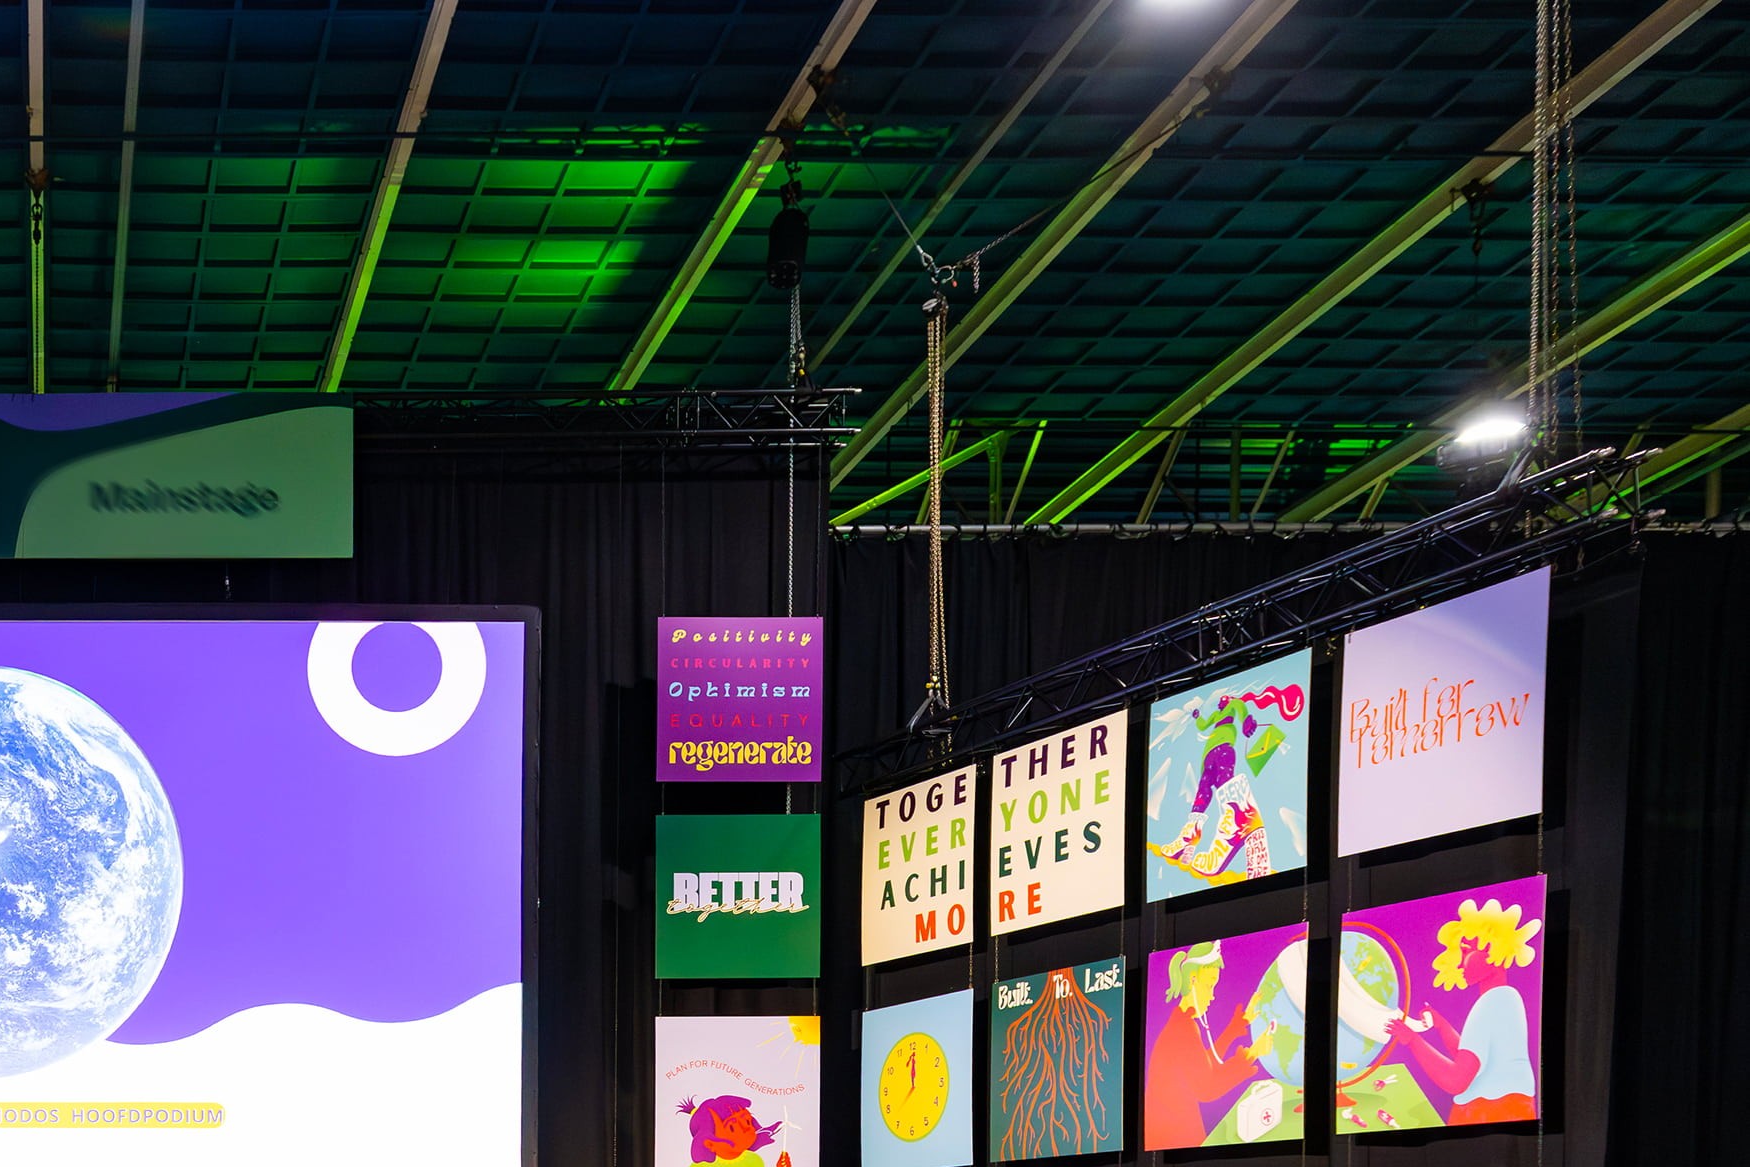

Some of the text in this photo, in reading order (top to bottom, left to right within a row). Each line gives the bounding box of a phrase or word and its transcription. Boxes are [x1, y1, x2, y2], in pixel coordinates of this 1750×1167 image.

[671, 629, 812, 647] Positivity
[670, 658, 809, 668] CIRCULARITY
[669, 681, 811, 701] Optimism
[1350, 677, 1474, 743] Built for
[670, 713, 809, 728] EQUALITY
[669, 735, 812, 772] regenerate
[1001, 724, 1108, 787] THER
[876, 773, 967, 829] TOGE
[1000, 769, 1110, 832] YONE
[878, 817, 966, 870] EVER
[999, 821, 1102, 878] EVES
[673, 872, 803, 911] BETTER
[881, 859, 965, 910] ACHI
[999, 882, 1042, 923] RE
[666, 897, 809, 923] together
[915, 903, 966, 943] MO
[665, 1060, 806, 1096] PLAN FOR FUTURE GENERATIONS
[71, 1108, 223, 1123] HOOFDPODIUM
